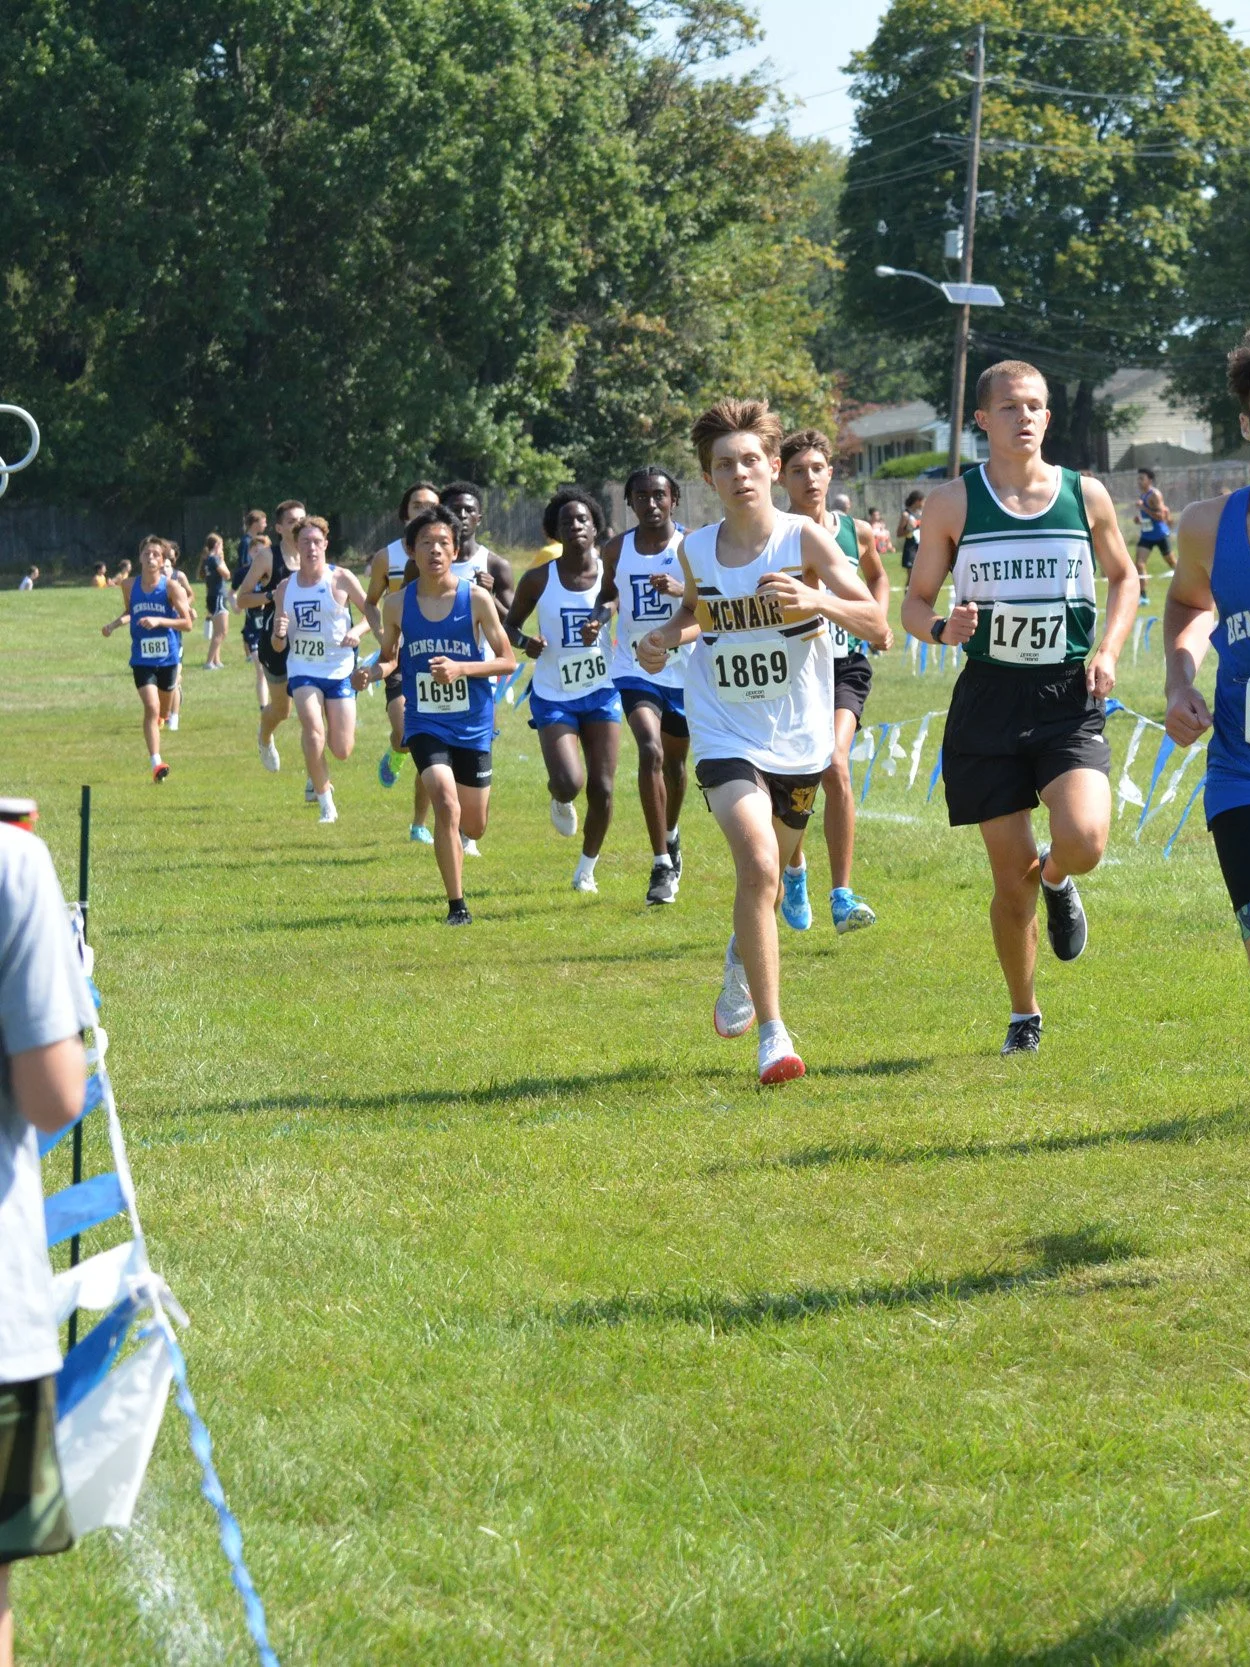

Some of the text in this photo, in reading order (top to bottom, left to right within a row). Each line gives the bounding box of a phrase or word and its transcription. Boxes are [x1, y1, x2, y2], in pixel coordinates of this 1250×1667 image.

[970, 558, 1083, 582] STEINERT XC
[993, 614, 1064, 650] 1757
[142, 641, 167, 654] 1681
[294, 639, 325, 657] 1728
[561, 655, 607, 685] 1736
[715, 650, 788, 688] 1869
[418, 679, 467, 703] 1699
